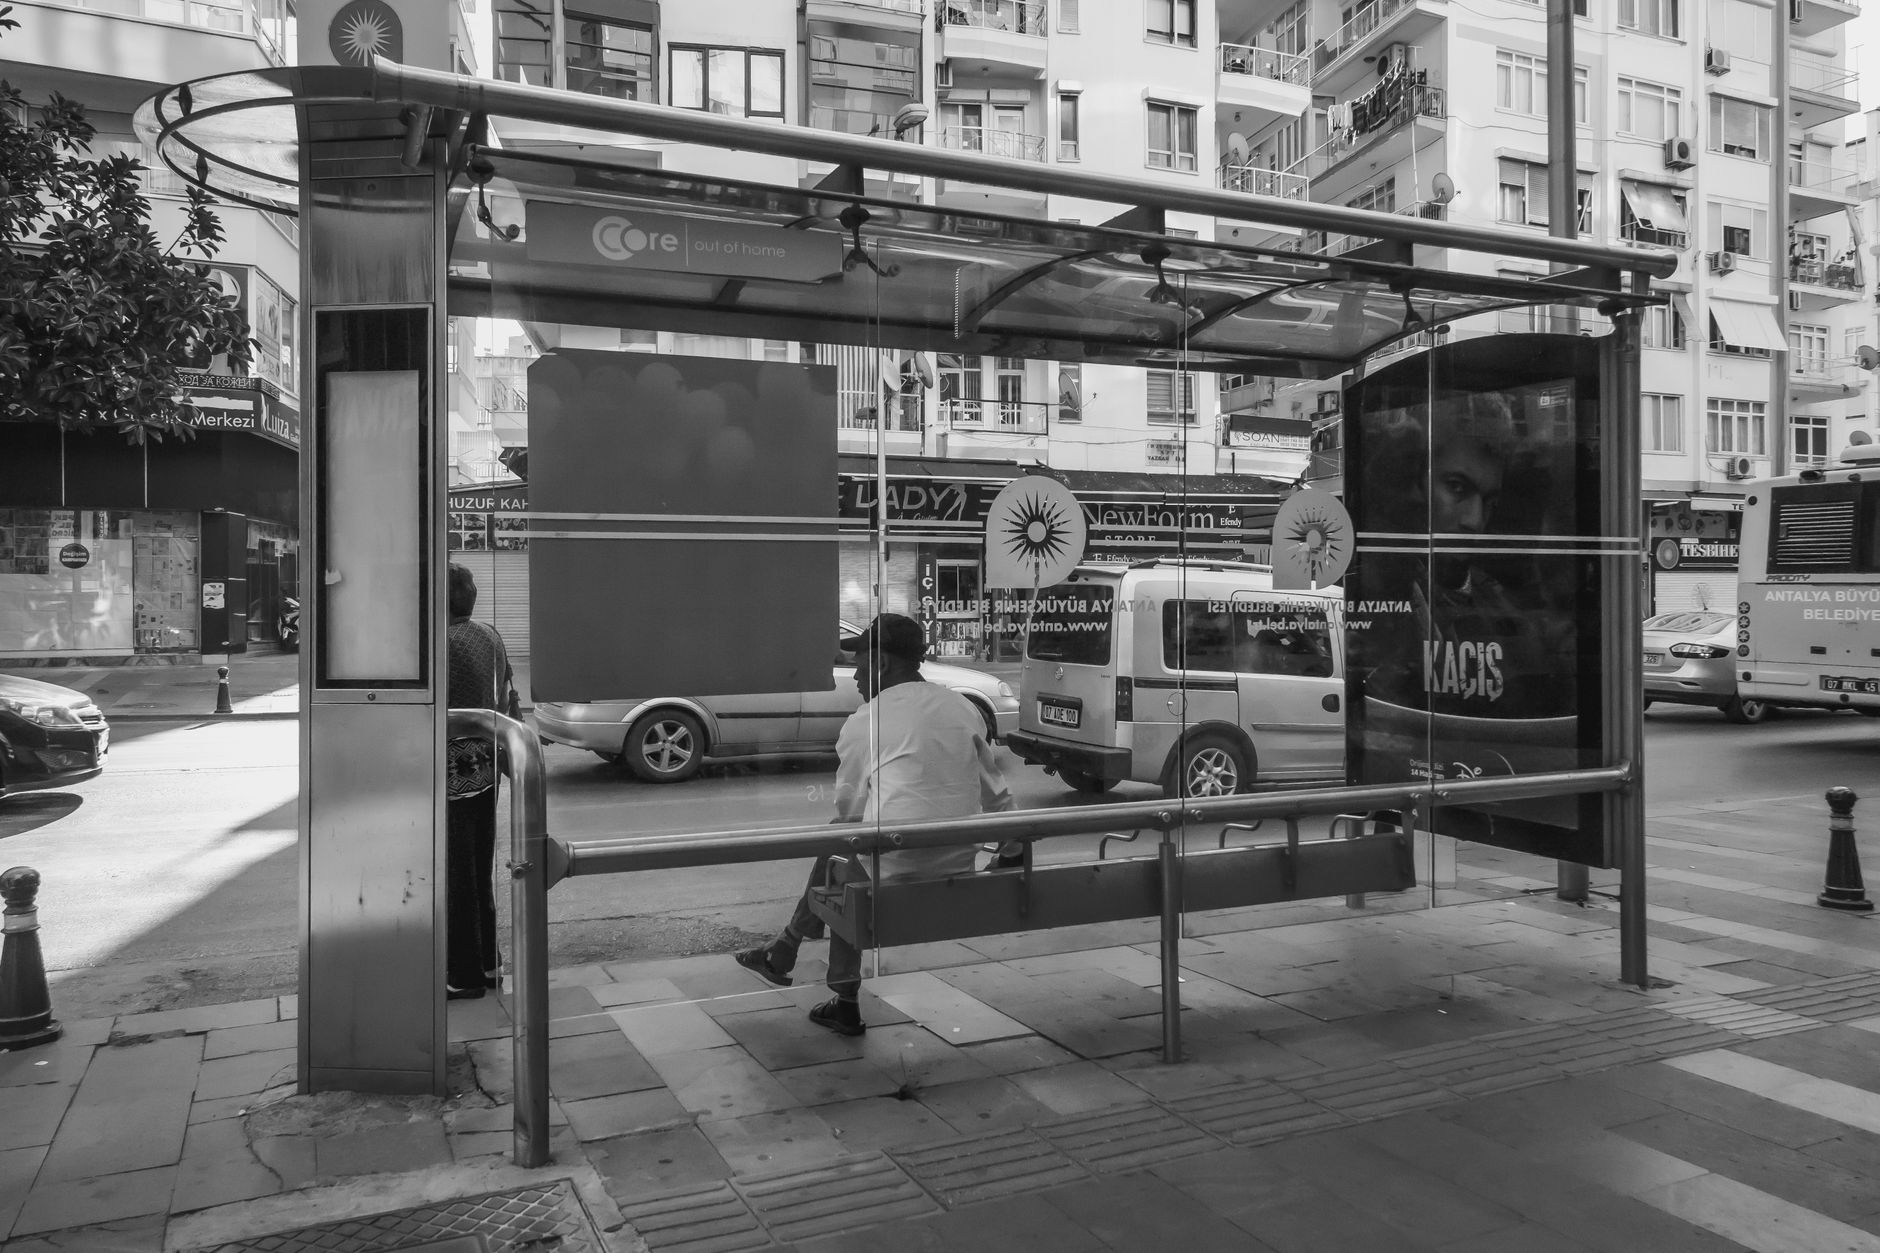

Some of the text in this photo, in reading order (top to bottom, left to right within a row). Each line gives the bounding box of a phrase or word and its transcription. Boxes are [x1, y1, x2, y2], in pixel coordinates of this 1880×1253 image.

[694, 240, 786, 258] out of home
[190, 411, 255, 428] Merkezi
[1242, 431, 1280, 443] SOAN
[856, 483, 951, 511] LADY
[1081, 502, 1215, 531] NewForm
[1220, 517, 1242, 527] Efendy
[1765, 591, 1832, 602] ANTALYA
[1423, 640, 1504, 702] KAÇIŞ
